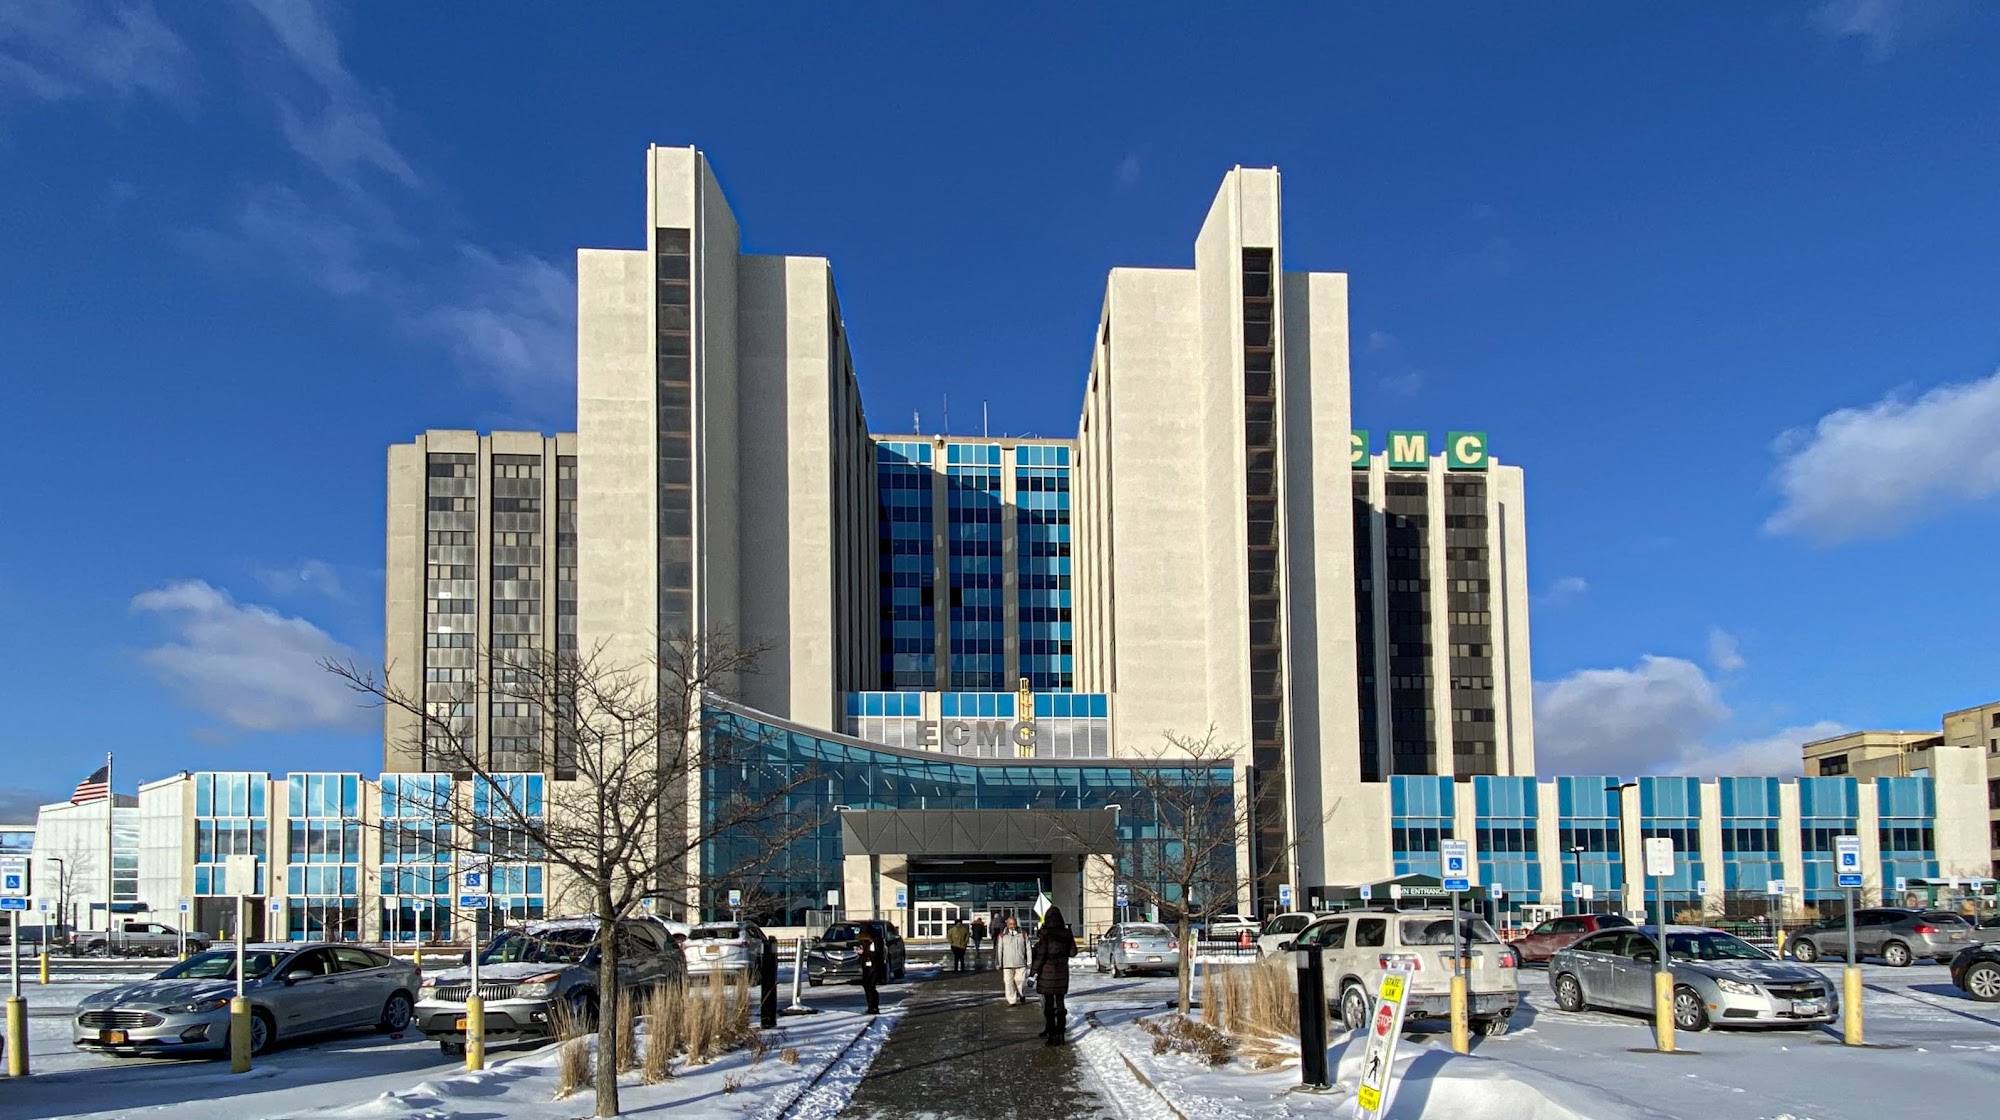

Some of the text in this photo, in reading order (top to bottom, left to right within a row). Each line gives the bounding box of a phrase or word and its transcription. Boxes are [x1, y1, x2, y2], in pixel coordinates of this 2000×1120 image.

[916, 720, 1038, 747] ECMC
[1385, 977, 1401, 988] STATE
[1377, 1015, 1393, 1028] STOP
